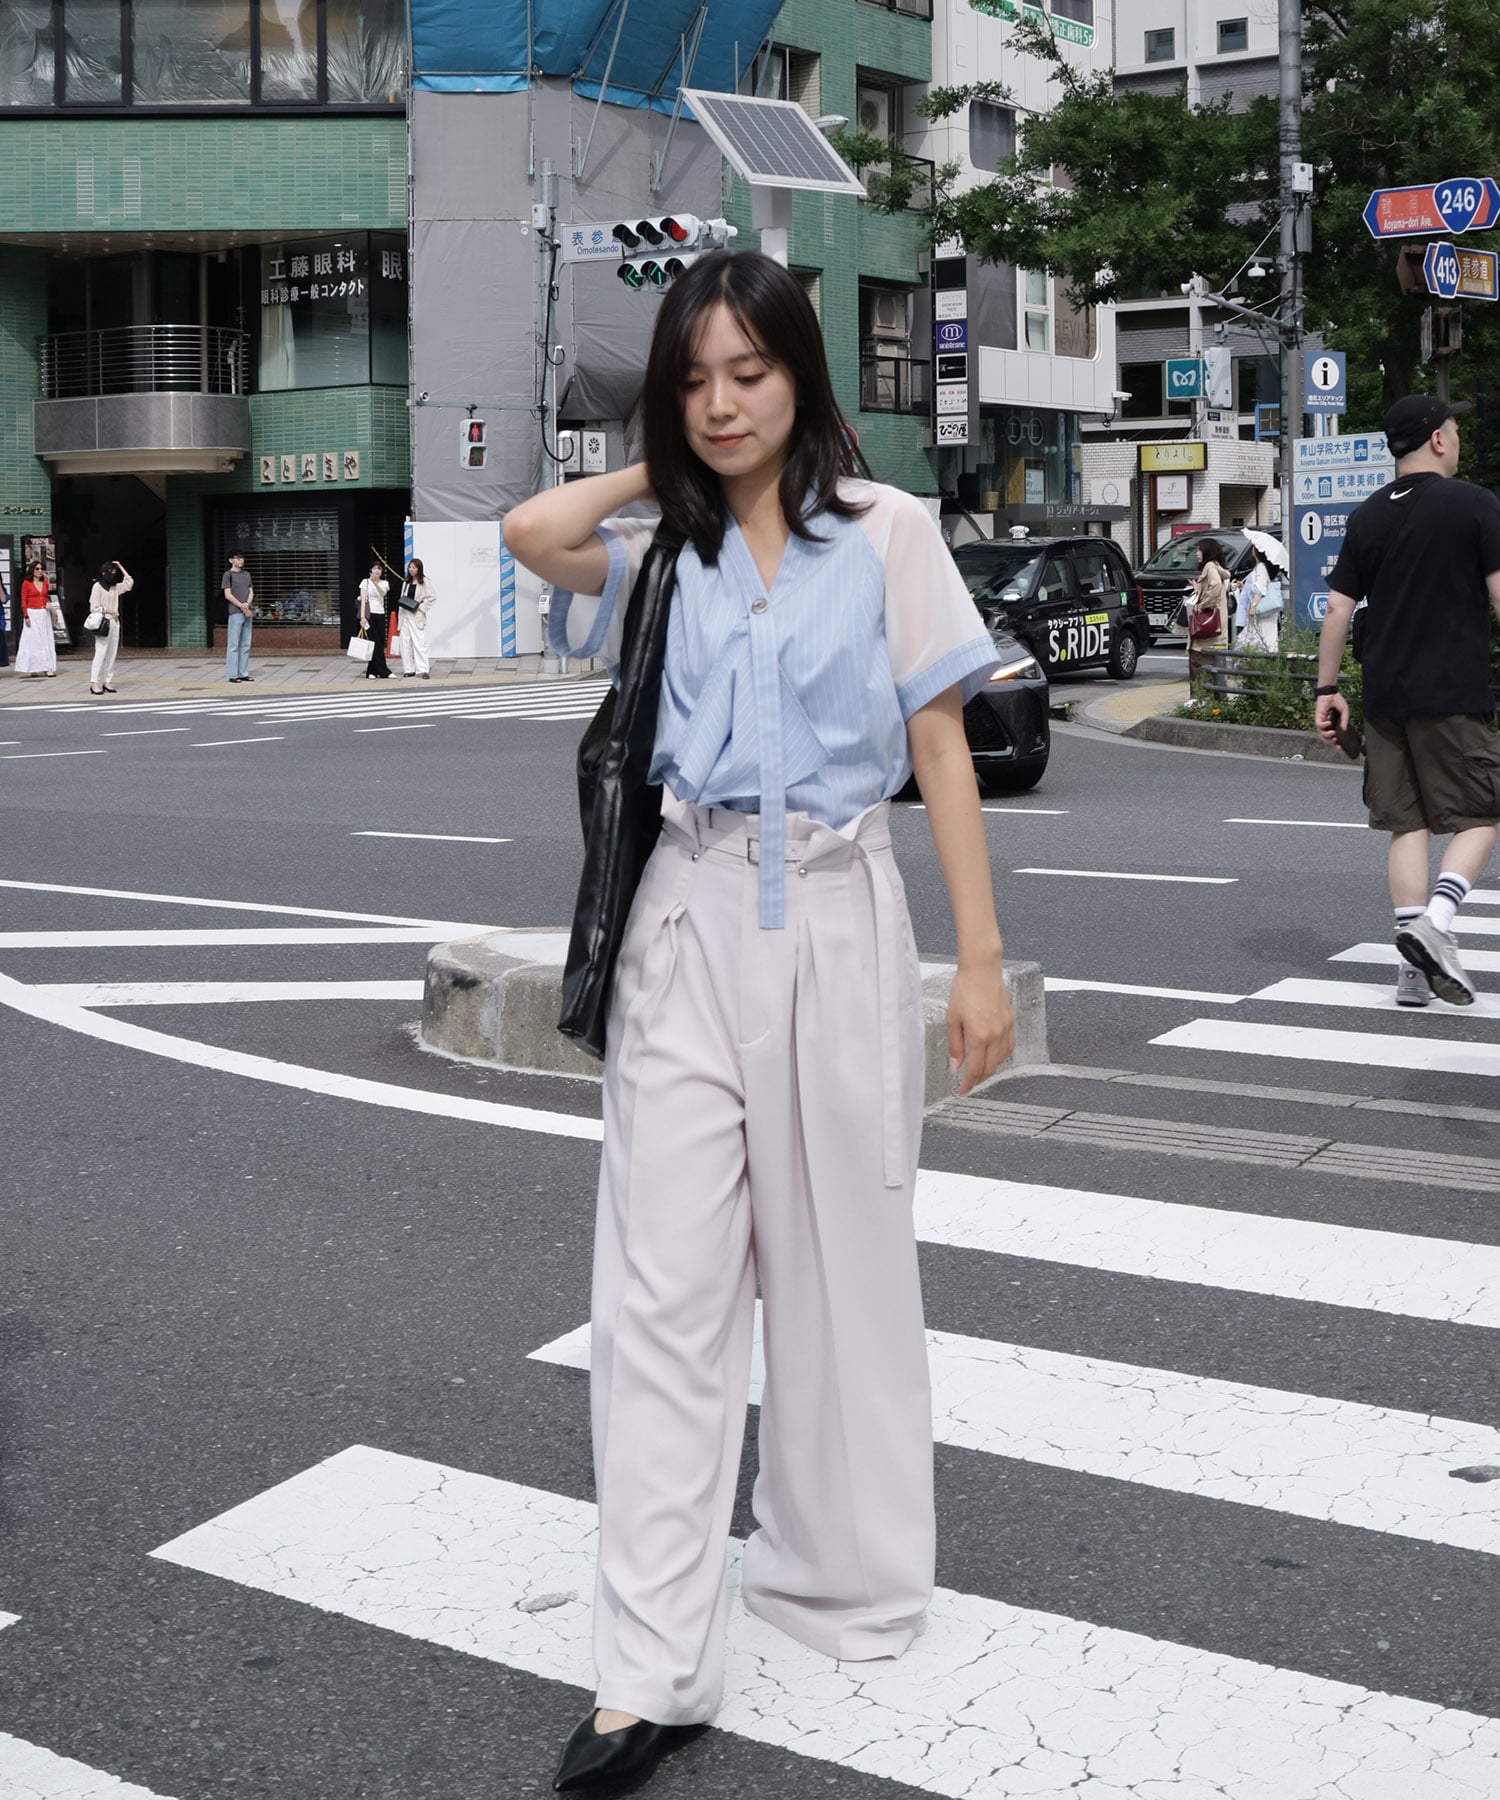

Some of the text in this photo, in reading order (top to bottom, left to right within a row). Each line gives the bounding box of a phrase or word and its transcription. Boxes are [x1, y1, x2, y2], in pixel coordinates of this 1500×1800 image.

[1442, 187, 1475, 214] 246
[1384, 216, 1418, 231] Aoyama-dori
[572, 230, 620, 246] 表参
[577, 245, 618, 255] Omotesando
[269, 250, 356, 280] 工藤眼科
[1436, 256, 1457, 285] 413
[1463, 257, 1488, 280] 表参道
[261, 279, 364, 305] 眼科診療一般コンタクト
[1300, 442, 1351, 457] 青山学院大学
[1337, 472, 1386, 488] 根津美術館
[1048, 615, 1084, 630] タクシーアプリ
[1049, 623, 1110, 663] S.RIDE
